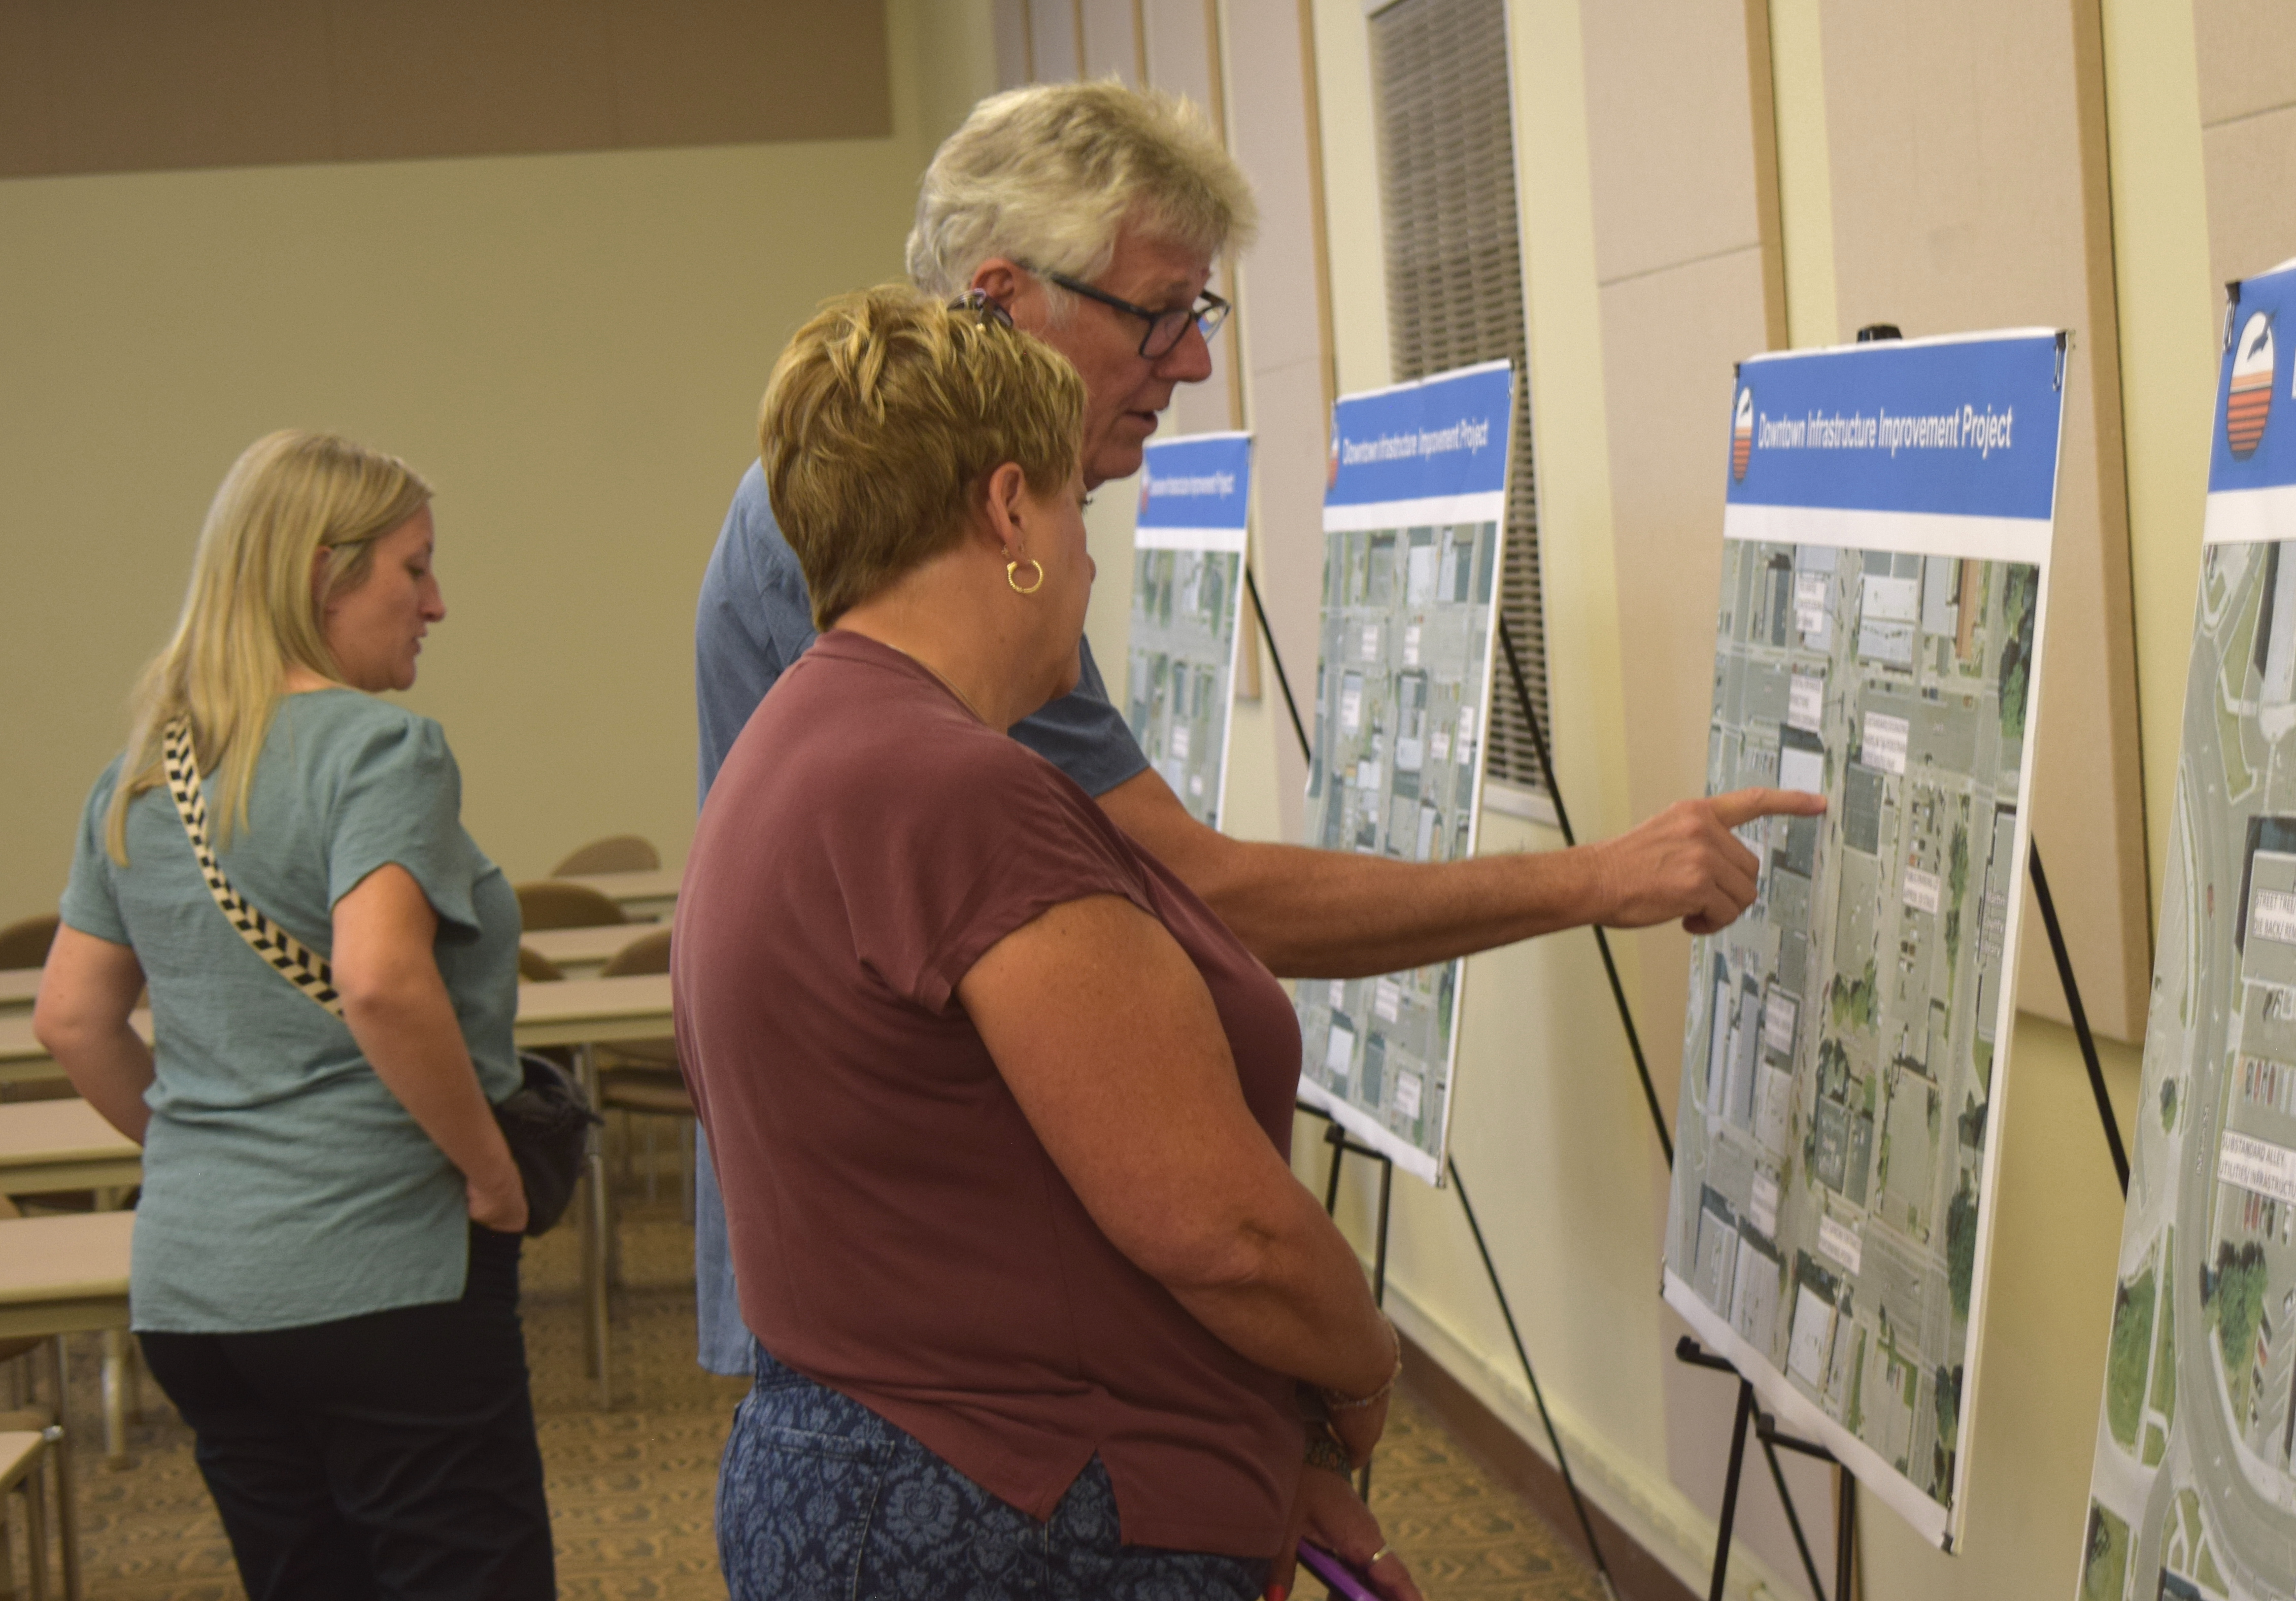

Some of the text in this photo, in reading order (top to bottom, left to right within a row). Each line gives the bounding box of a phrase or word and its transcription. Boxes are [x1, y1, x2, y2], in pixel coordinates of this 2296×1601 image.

[1758, 403, 2013, 460] Downtown Infrastructure Improvement Project
[2255, 892, 2278, 911] STREET
[2222, 1134, 2285, 1167] SUBSTANDARD ALLEY
